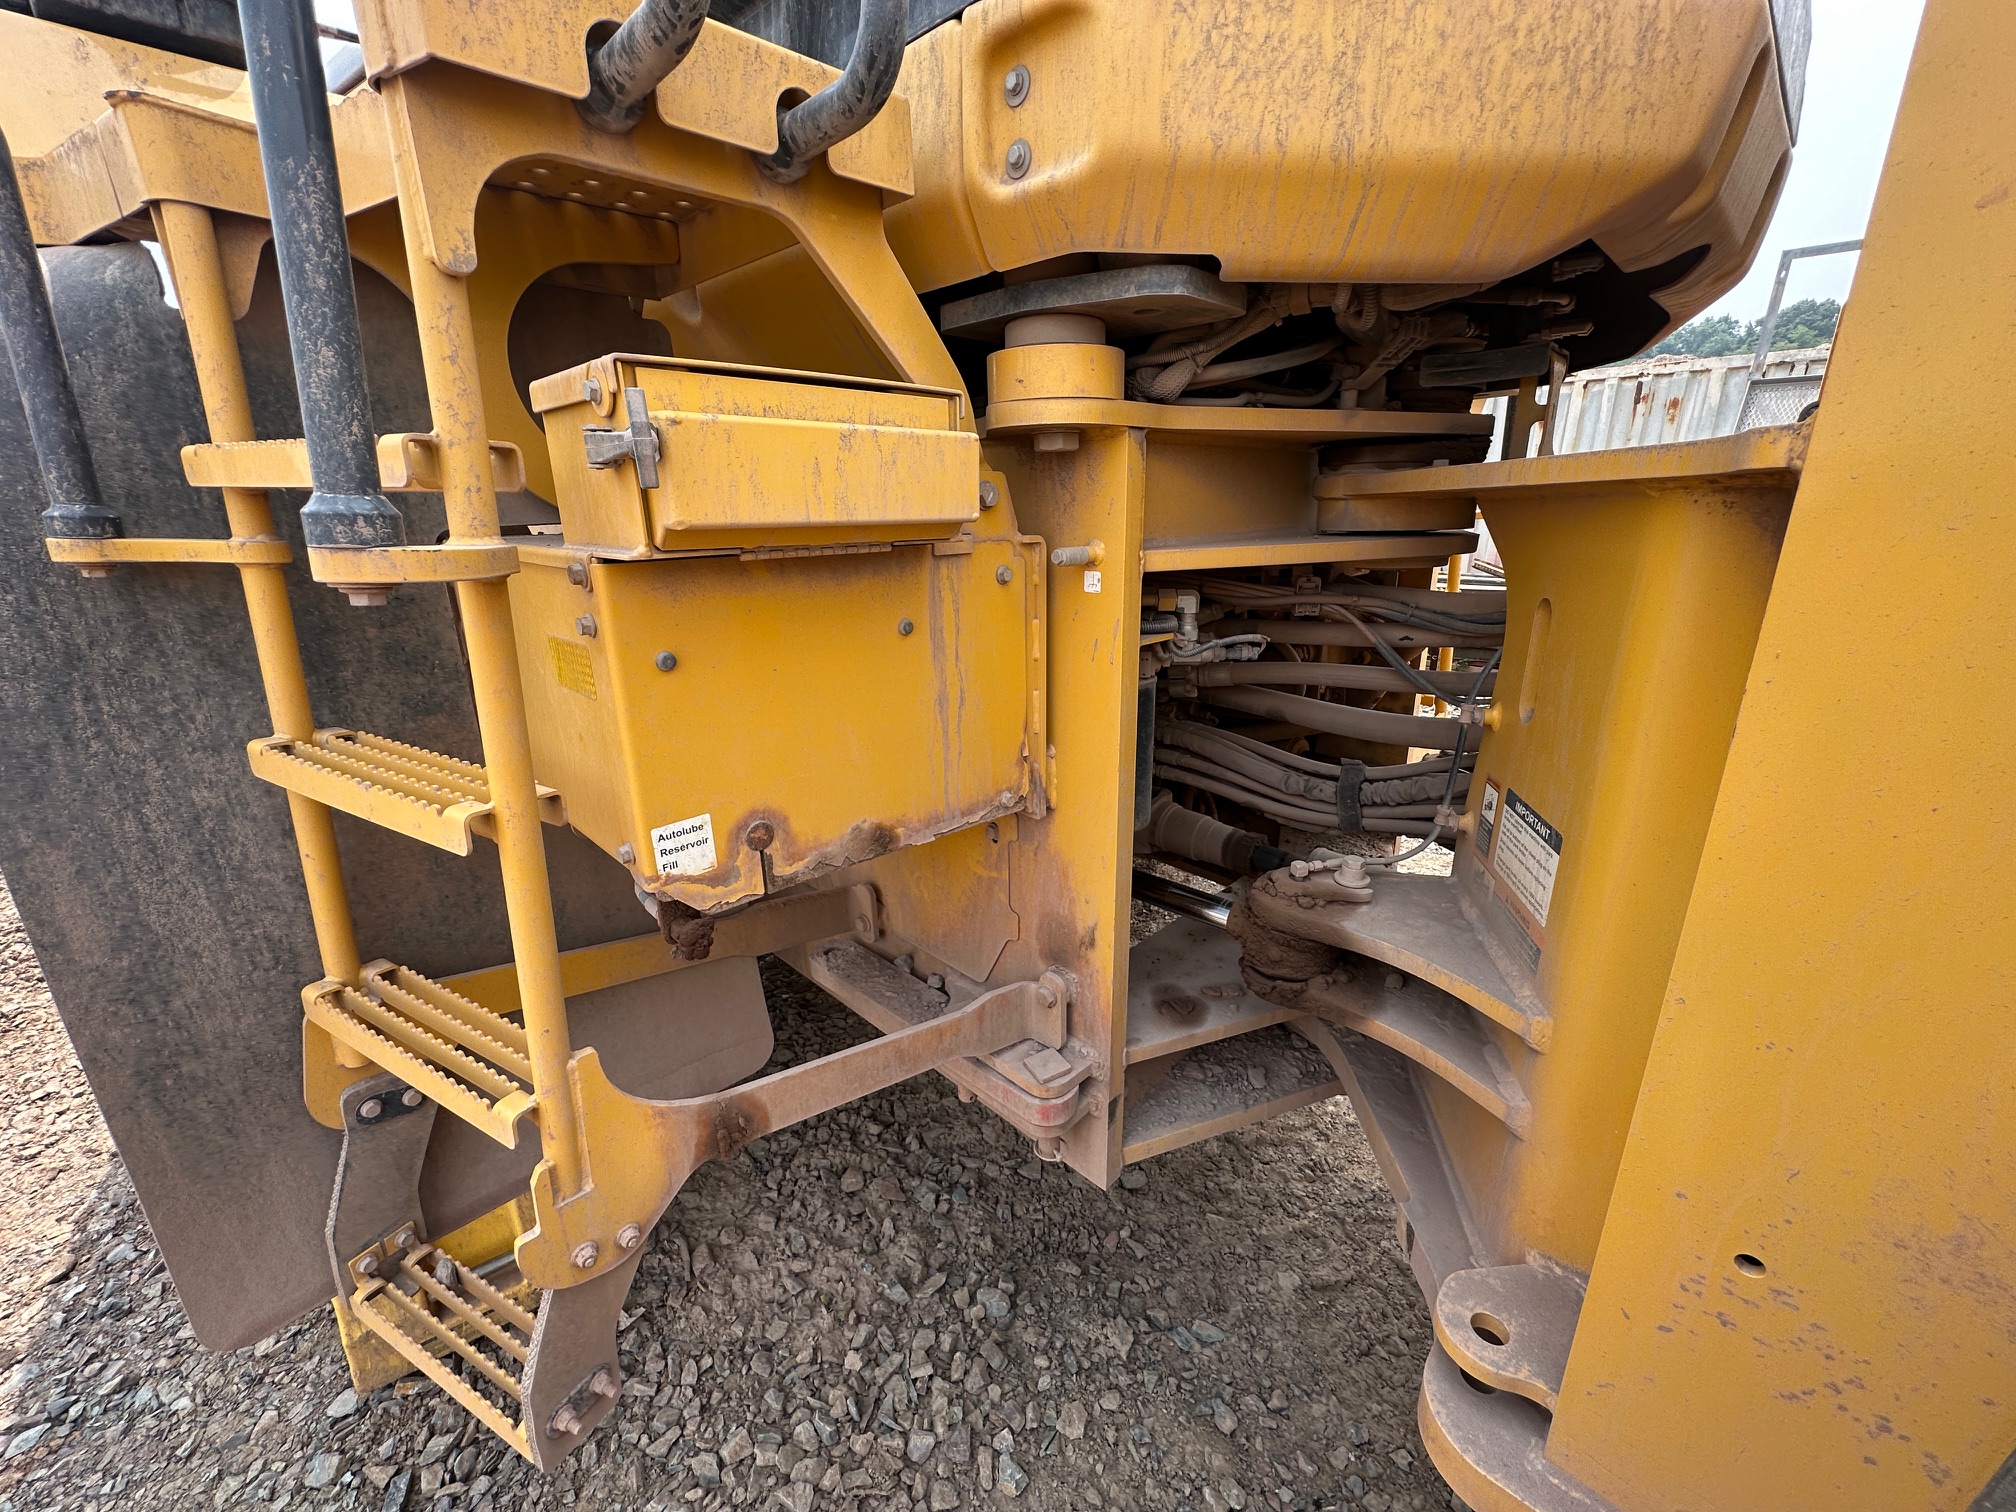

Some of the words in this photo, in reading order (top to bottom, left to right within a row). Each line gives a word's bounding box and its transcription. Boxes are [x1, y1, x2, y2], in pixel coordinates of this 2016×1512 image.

[1514, 801, 1550, 840] IMPORTANT
[658, 824, 704, 843] Autolube
[660, 837, 708, 857] Reservoir
[662, 861, 678, 872] Fill
